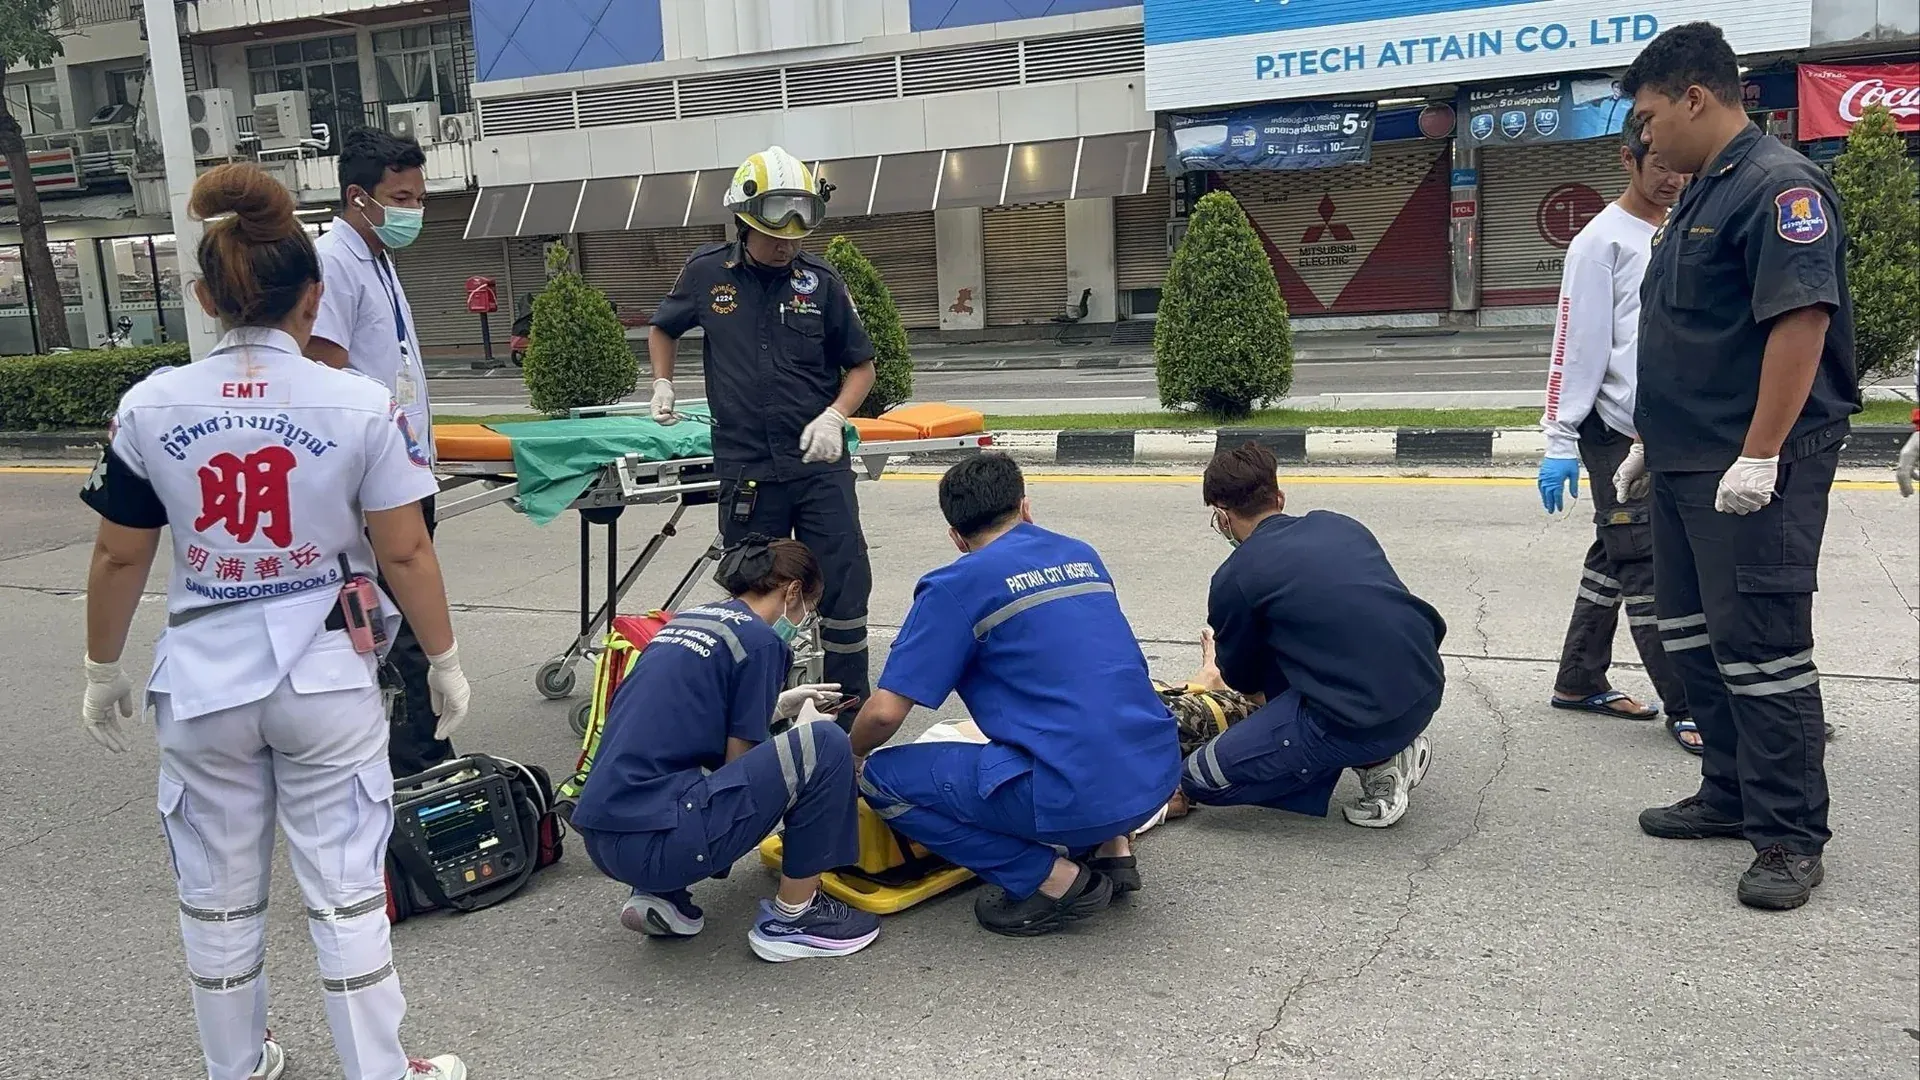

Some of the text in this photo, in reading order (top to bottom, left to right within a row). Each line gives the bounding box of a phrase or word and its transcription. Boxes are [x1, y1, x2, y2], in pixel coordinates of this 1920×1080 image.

[1256, 14, 1658, 80] P.TECH ATTAIN CO. LTD
[1342, 113, 1359, 135] 5
[1330, 142, 1340, 152] 10
[1453, 206, 1474, 214] TCL
[1299, 245, 1357, 256] MITSUBISHI
[1299, 255, 1349, 267] ELECTRIC
[711, 301, 738, 314] RESCUE
[222, 382, 268, 399] EMT
[187, 542, 322, 582] 明满善坛
[329, 568, 338, 581] 9
[1005, 562, 1100, 594] PATTAYA CITY HOSPITAL
[684, 629, 717, 647] MEDICINE
[680, 638, 711, 658] PHAYAO
